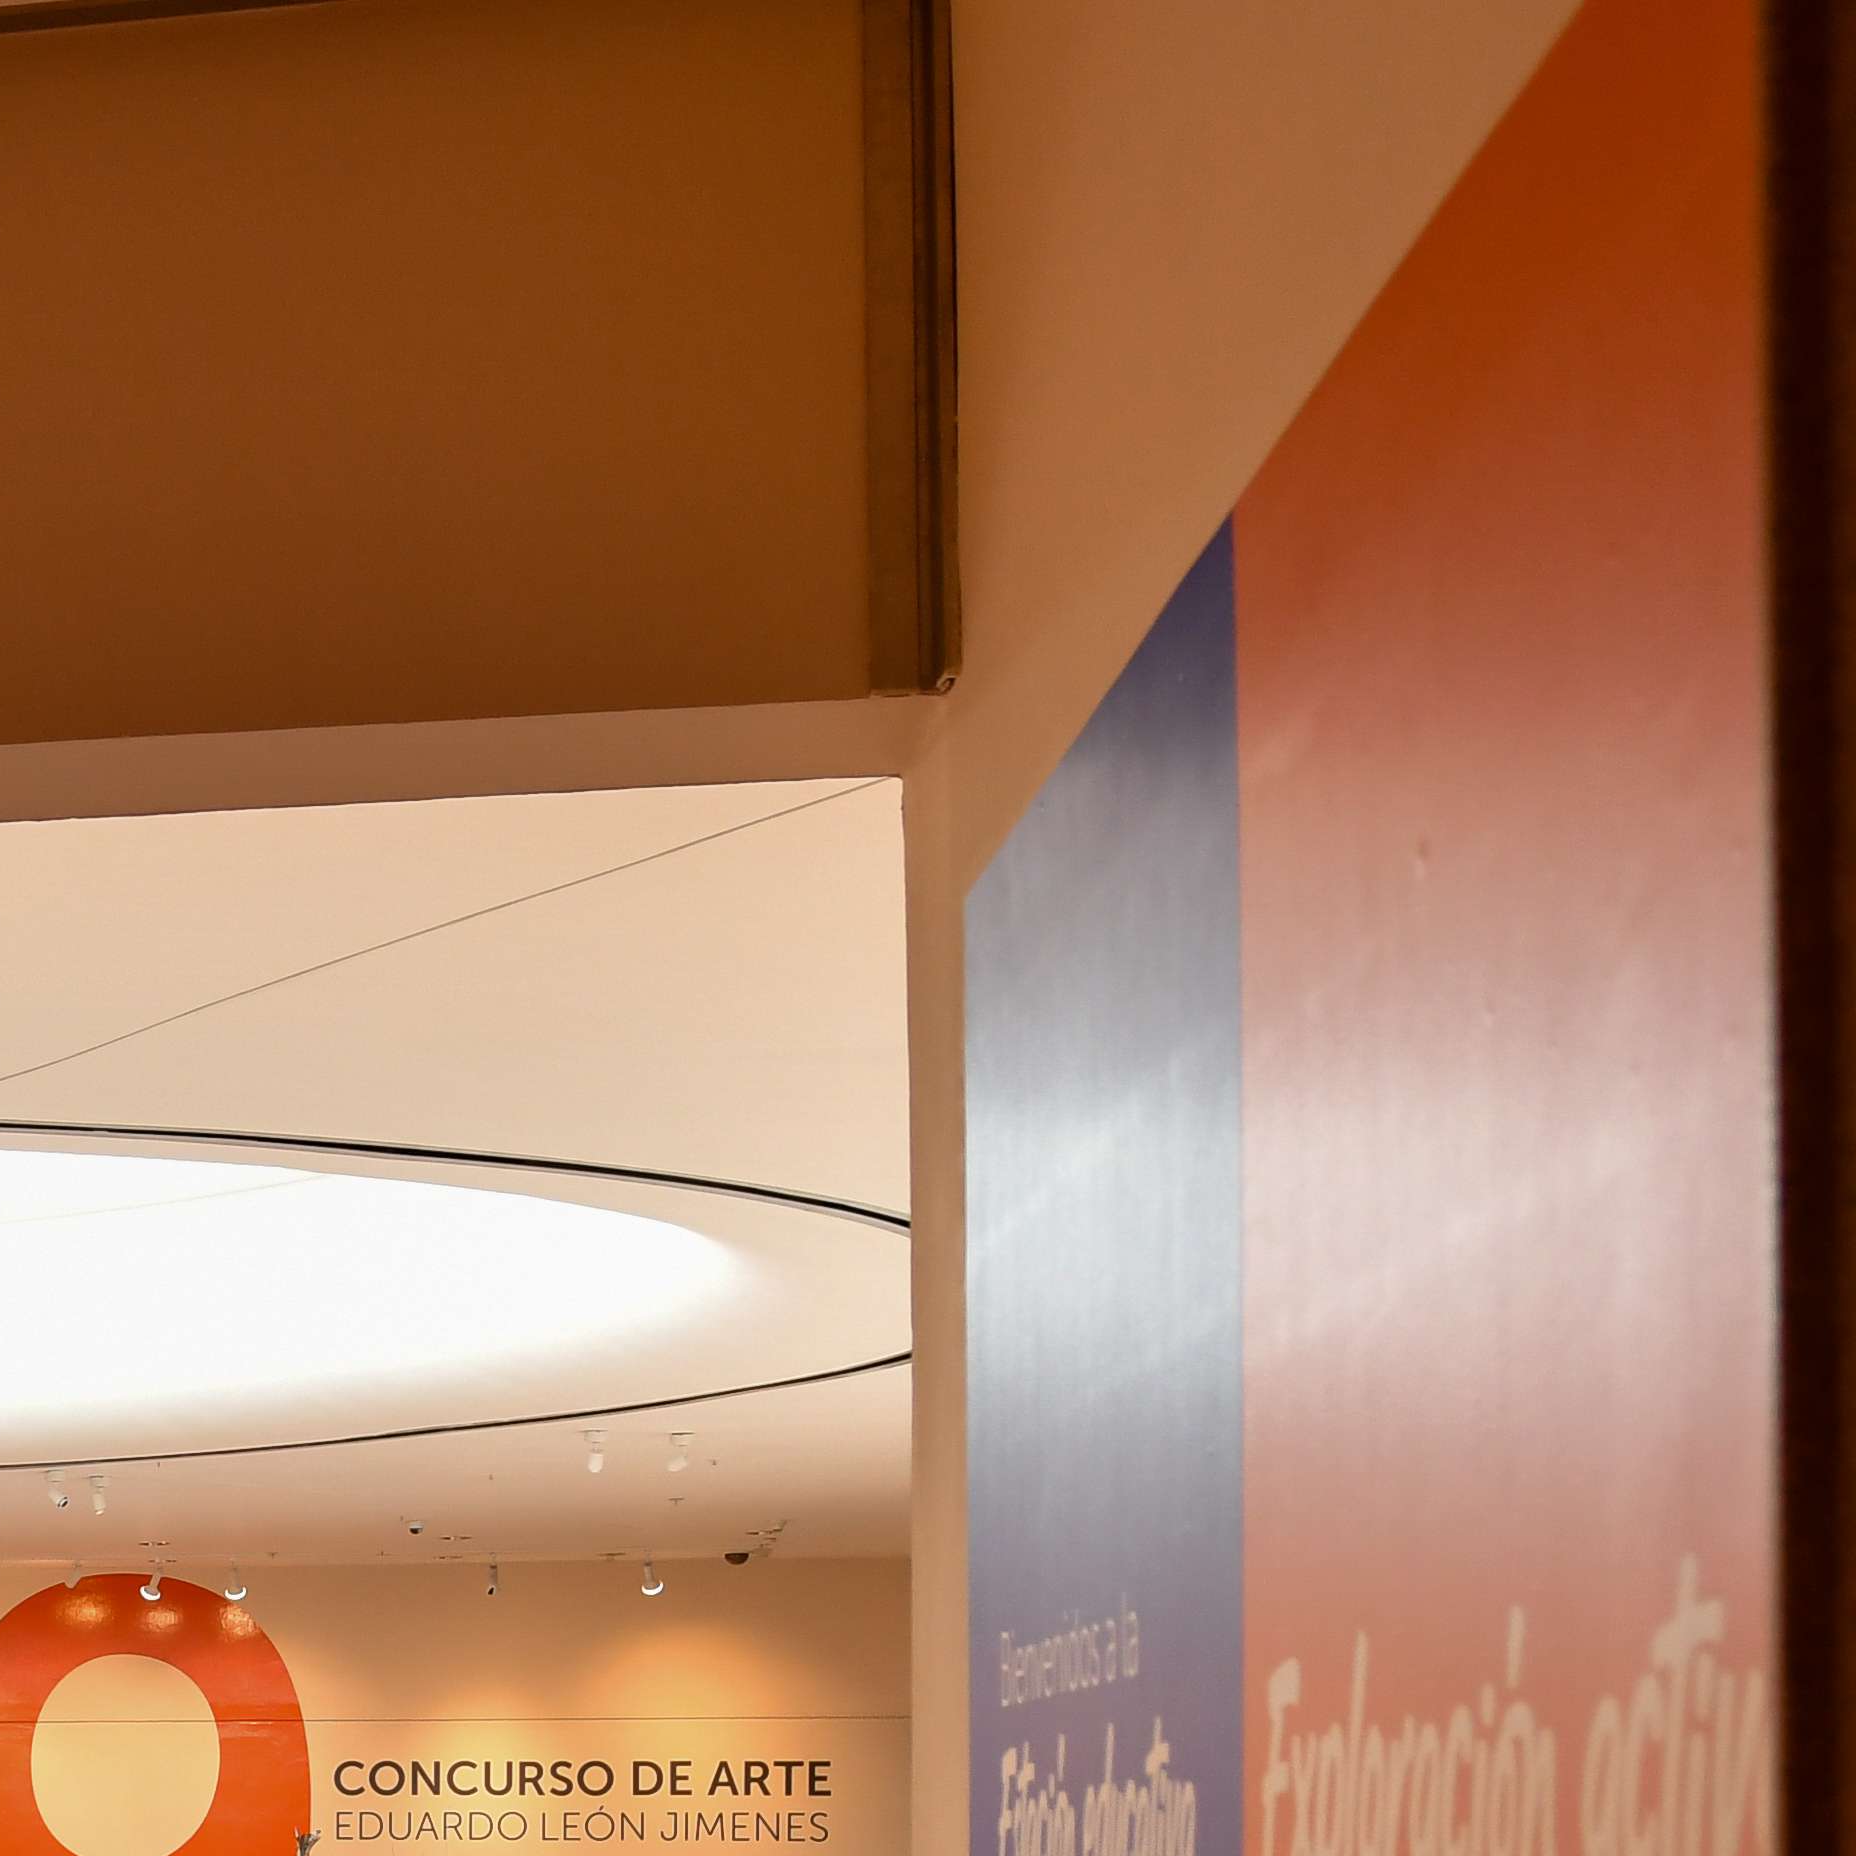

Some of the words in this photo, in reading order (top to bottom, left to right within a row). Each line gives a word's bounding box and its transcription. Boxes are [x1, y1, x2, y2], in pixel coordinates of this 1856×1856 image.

[1000, 1608, 1100, 1707] Bienvenidos
[334, 1760, 615, 1797] CONCURSO
[632, 1761, 694, 1797] DE
[708, 1761, 833, 1797] ARTE
[335, 1811, 529, 1843] EDUARDO
[541, 1805, 646, 1842] LEÓN
[659, 1811, 830, 1843] JIMENES
